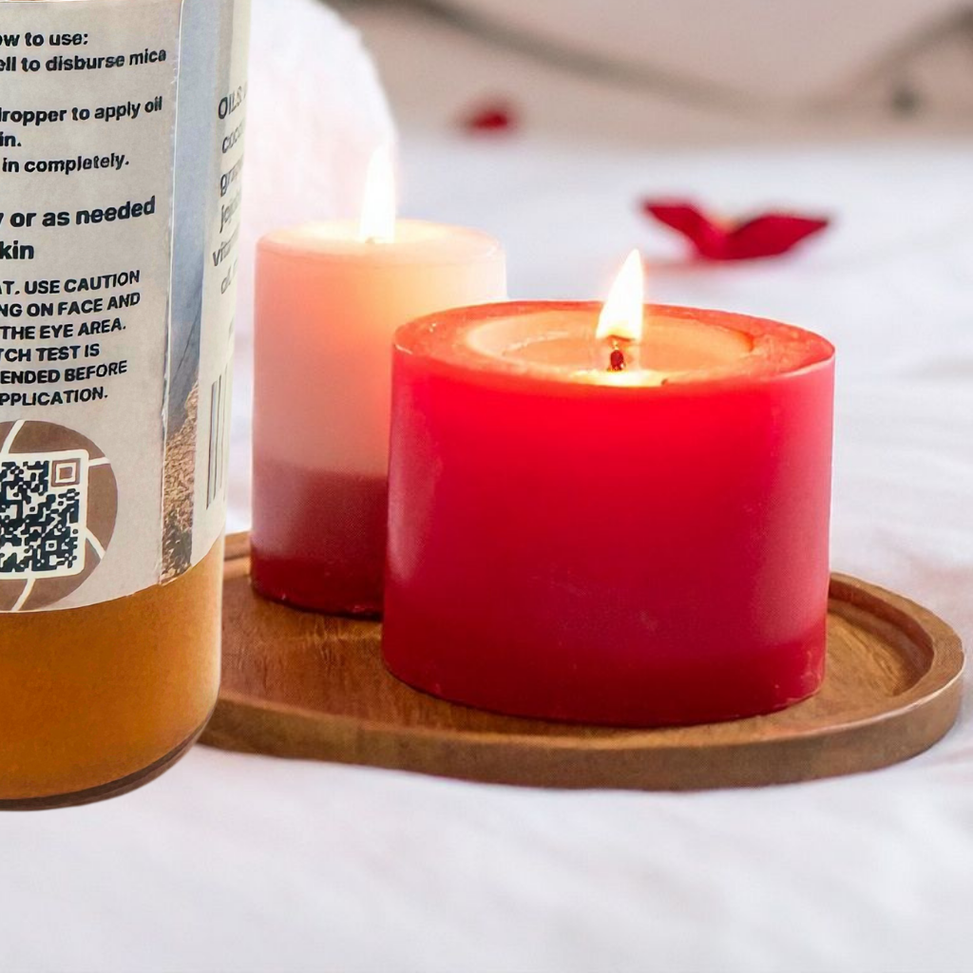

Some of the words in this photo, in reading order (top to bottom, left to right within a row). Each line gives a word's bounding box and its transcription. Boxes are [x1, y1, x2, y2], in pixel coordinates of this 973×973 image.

[25, 32, 44, 47] to
[49, 33, 89, 45] use:
[21, 57, 40, 71] to
[45, 53, 125, 71] disburse
[129, 49, 167, 65] mica
[72, 107, 90, 120] to
[95, 101, 140, 121] apply
[145, 97, 163, 112] oil
[3, 158, 19, 172] in
[24, 153, 129, 174] completely.
[11, 211, 36, 227] or
[42, 210, 69, 226] as
[76, 195, 155, 225] needed
[25, 280, 59, 294] USE
[64, 270, 139, 292] CAUTION
[27, 302, 53, 317] ON
[58, 298, 103, 315] FACE
[107, 292, 140, 310] AND
[0, 325, 35, 339] THE
[40, 323, 73, 338] EYE
[78, 317, 126, 336] AREA.
[35, 345, 80, 361] TEST
[84, 344, 99, 357] IS
[65, 360, 127, 381] BEFORE
